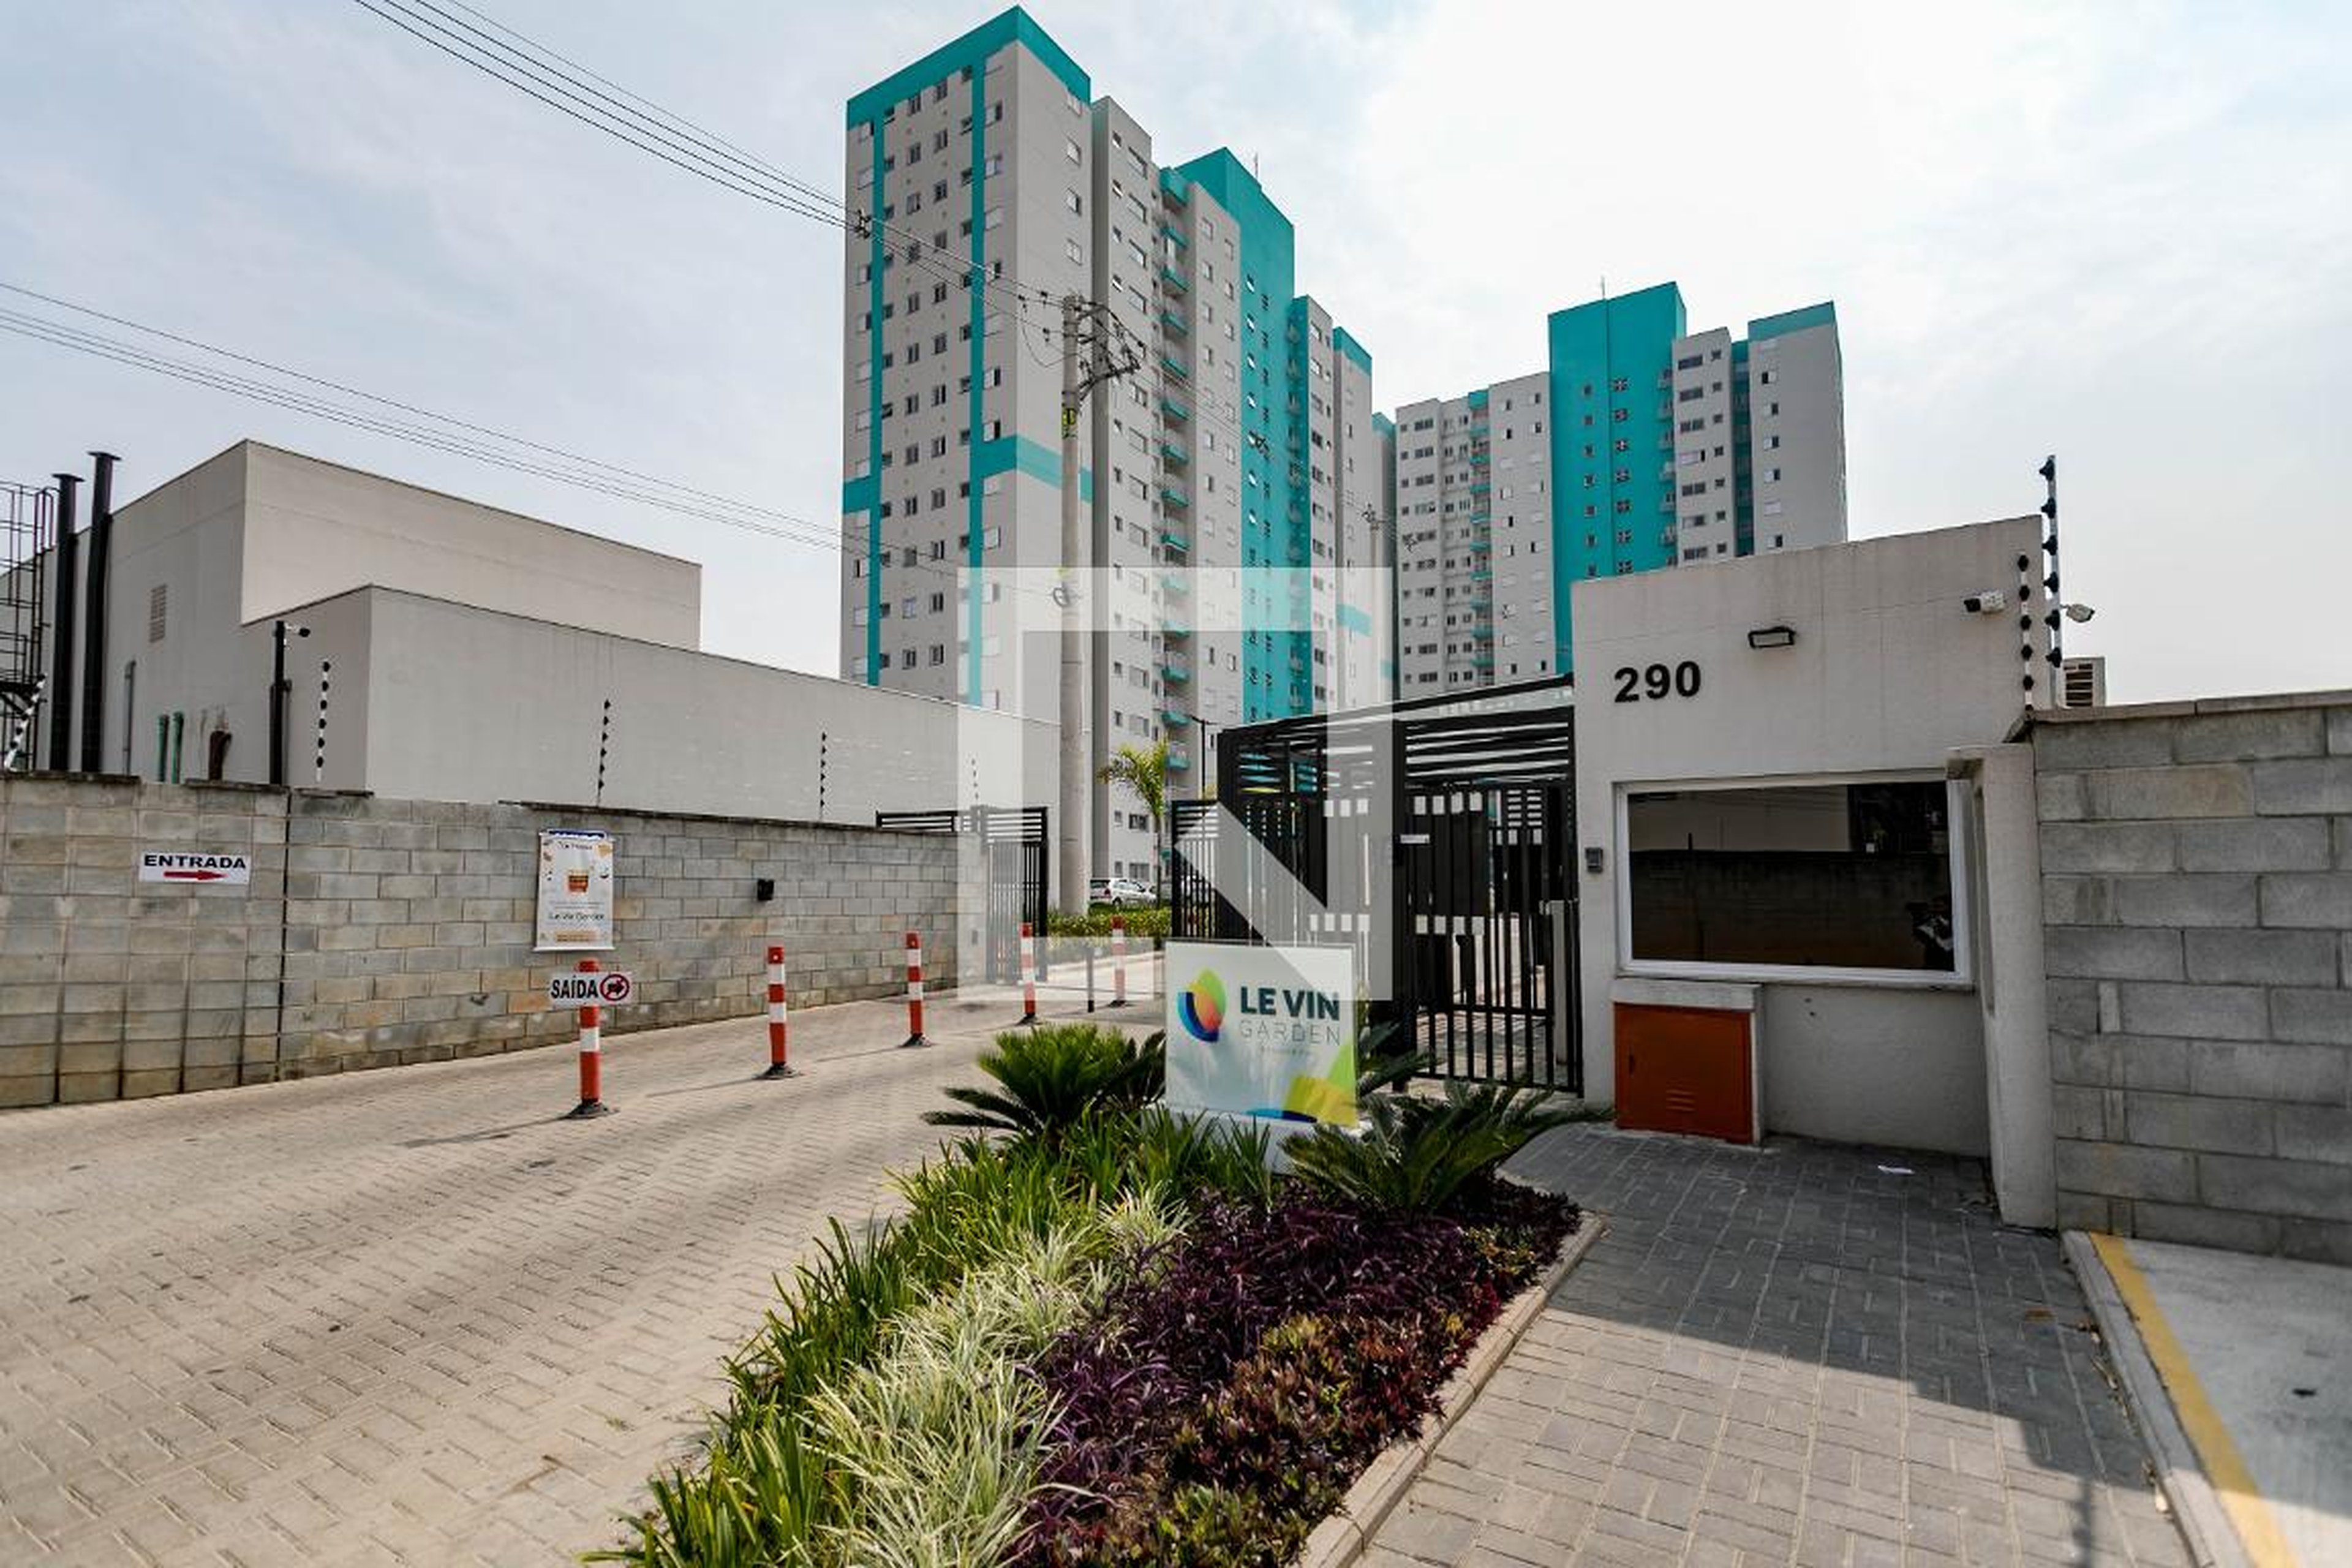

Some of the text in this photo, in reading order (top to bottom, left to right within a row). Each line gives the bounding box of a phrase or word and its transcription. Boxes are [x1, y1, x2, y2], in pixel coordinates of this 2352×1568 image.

[1614, 660, 1701, 703] 290
[144, 854, 246, 869] ENTRADA
[551, 975, 598, 998] SAÍDA
[1240, 987, 1340, 1020] LE VIN
[1240, 1020, 1340, 1046] GARDEN
